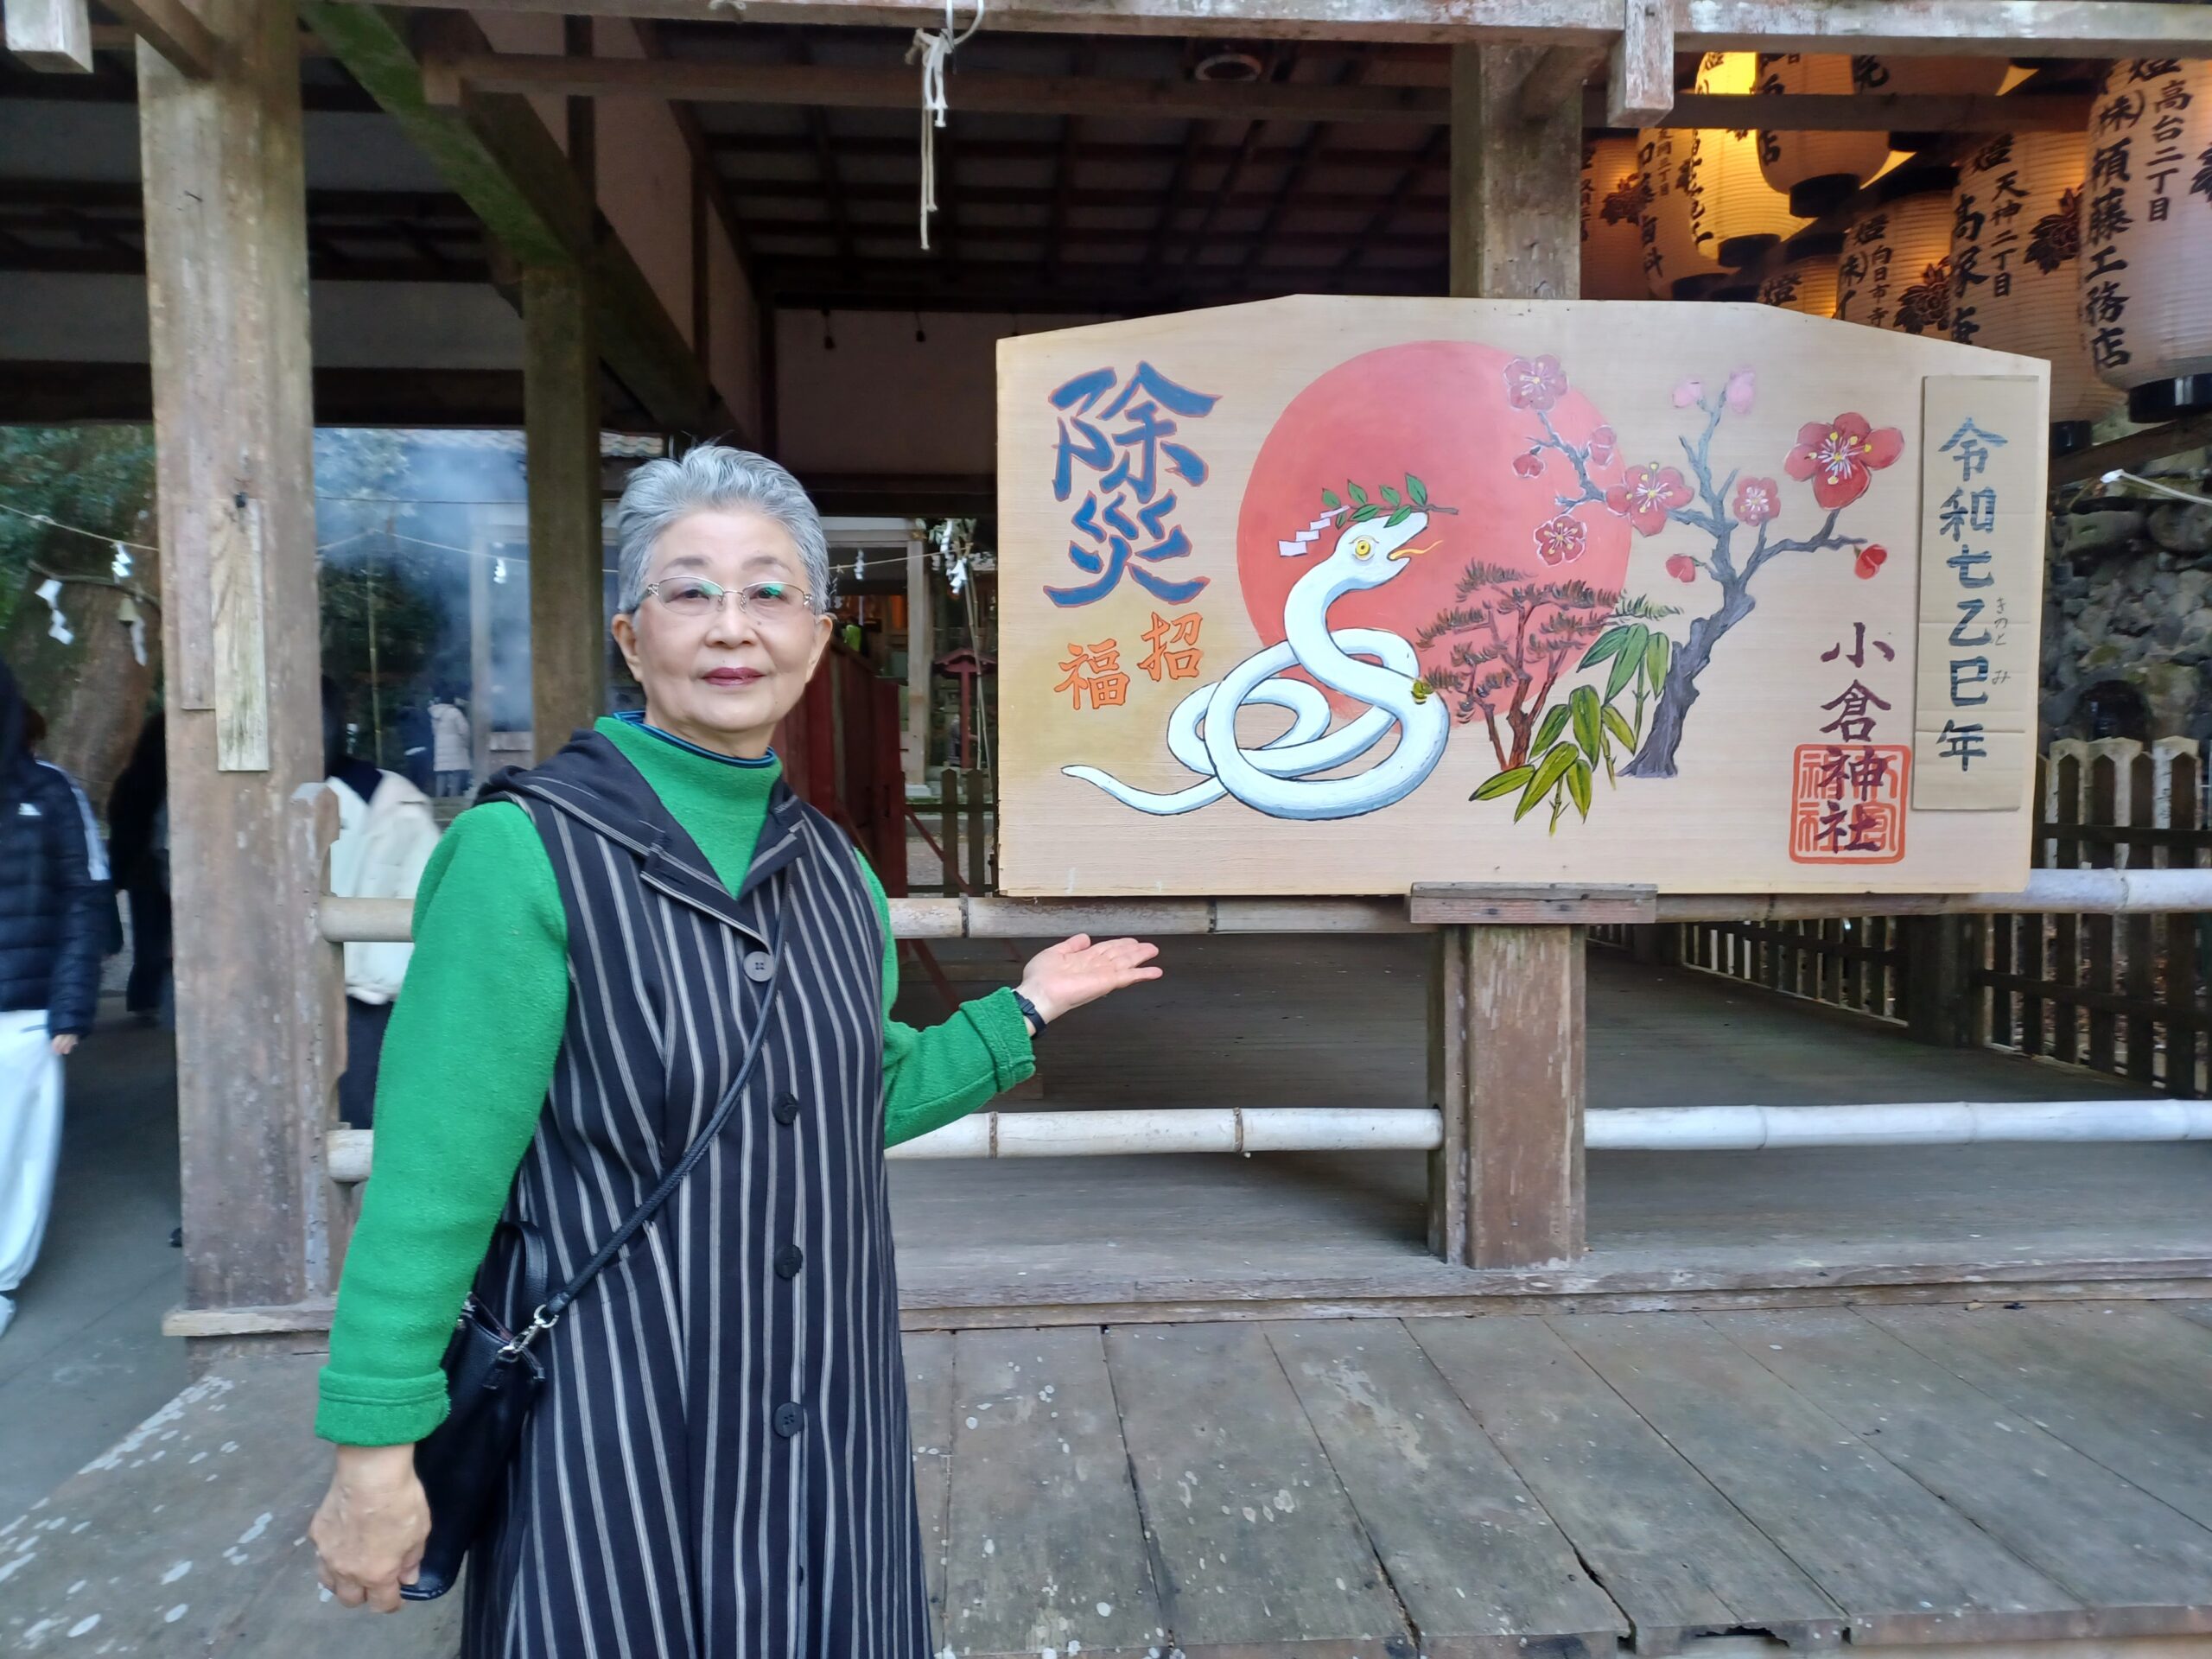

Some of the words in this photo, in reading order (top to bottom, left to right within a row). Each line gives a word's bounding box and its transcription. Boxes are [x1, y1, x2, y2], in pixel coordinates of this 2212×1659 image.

[1990, 169, 2031, 298] 天神二丁目
[2146, 79, 2193, 222] 高台二丁目
[1042, 359, 1224, 608] 除災
[1936, 416, 2009, 772] 令和七乙巳年
[1814, 620, 1896, 855] 小倉神社
